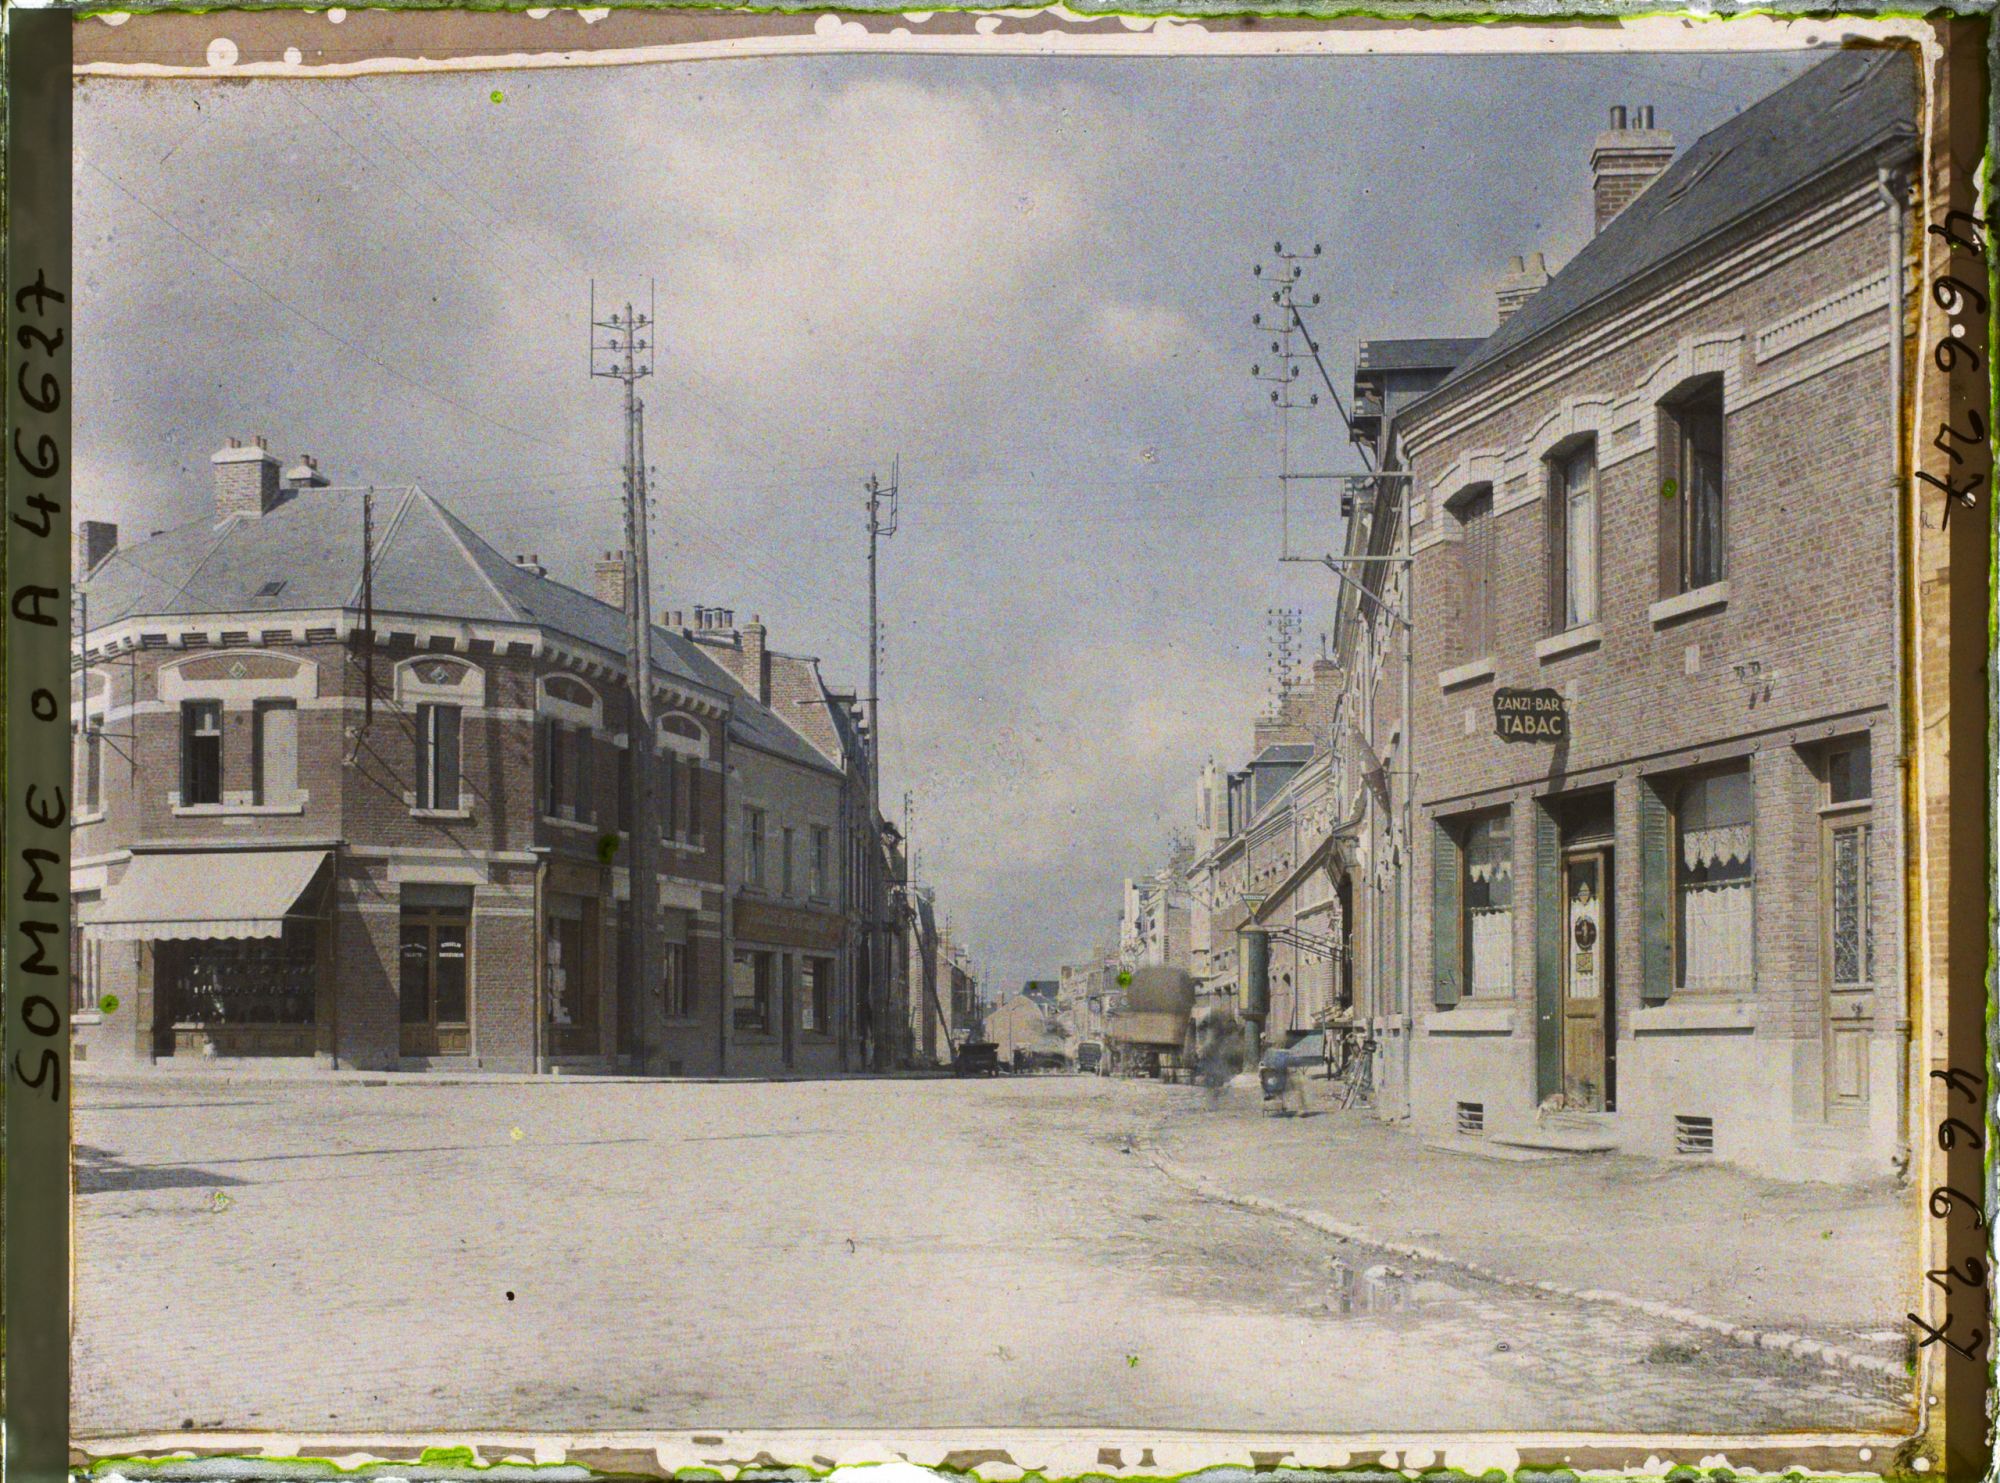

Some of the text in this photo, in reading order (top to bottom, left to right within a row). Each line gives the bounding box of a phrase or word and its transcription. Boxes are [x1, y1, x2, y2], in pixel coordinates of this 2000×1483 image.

[9, 268, 65, 538] 46627
[1915, 210, 1987, 532] 46627
[12, 584, 60, 627] A
[1497, 697, 1560, 711] ZANZI-BAR
[1501, 715, 1562, 735] TABAC
[15, 784, 66, 1101] SOMME
[1907, 1068, 1984, 1361] 46627
